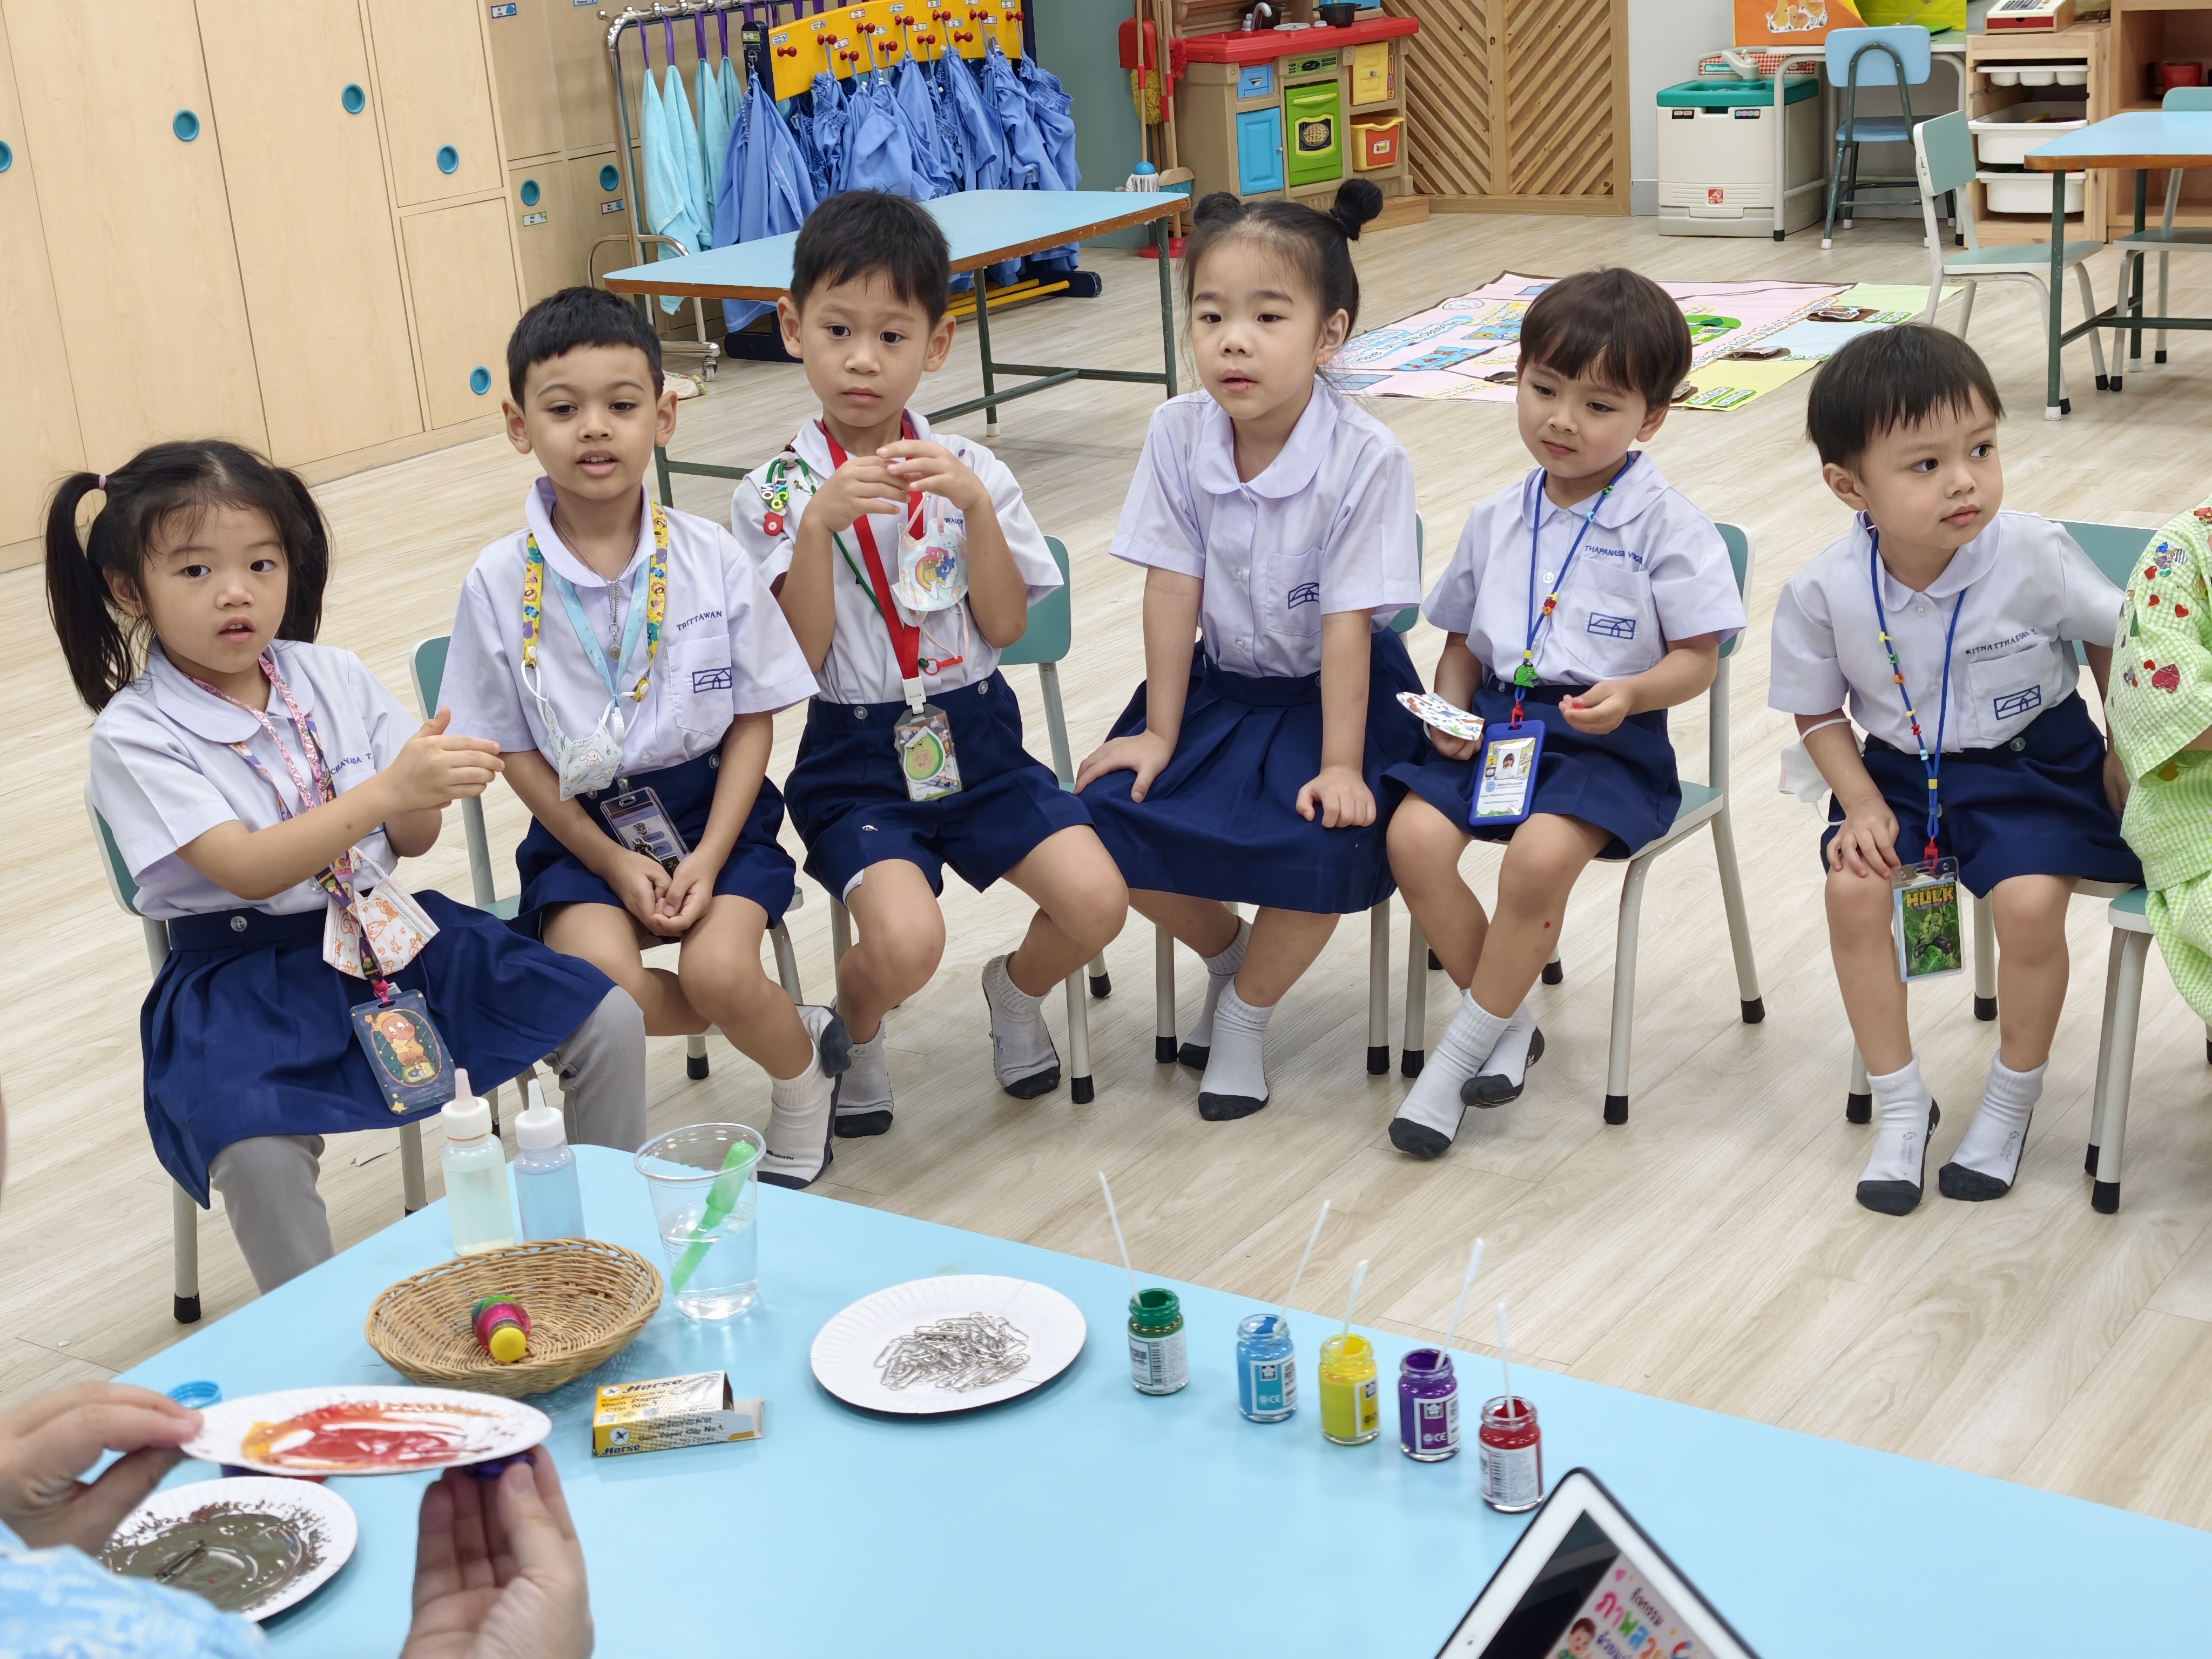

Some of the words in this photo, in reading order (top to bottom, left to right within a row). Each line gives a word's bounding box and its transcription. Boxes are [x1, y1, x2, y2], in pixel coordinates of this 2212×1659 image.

[676, 610, 722, 631] TRITTAWAN
[1906, 887, 1954, 908] HULK
[602, 1444, 640, 1455] Horse
